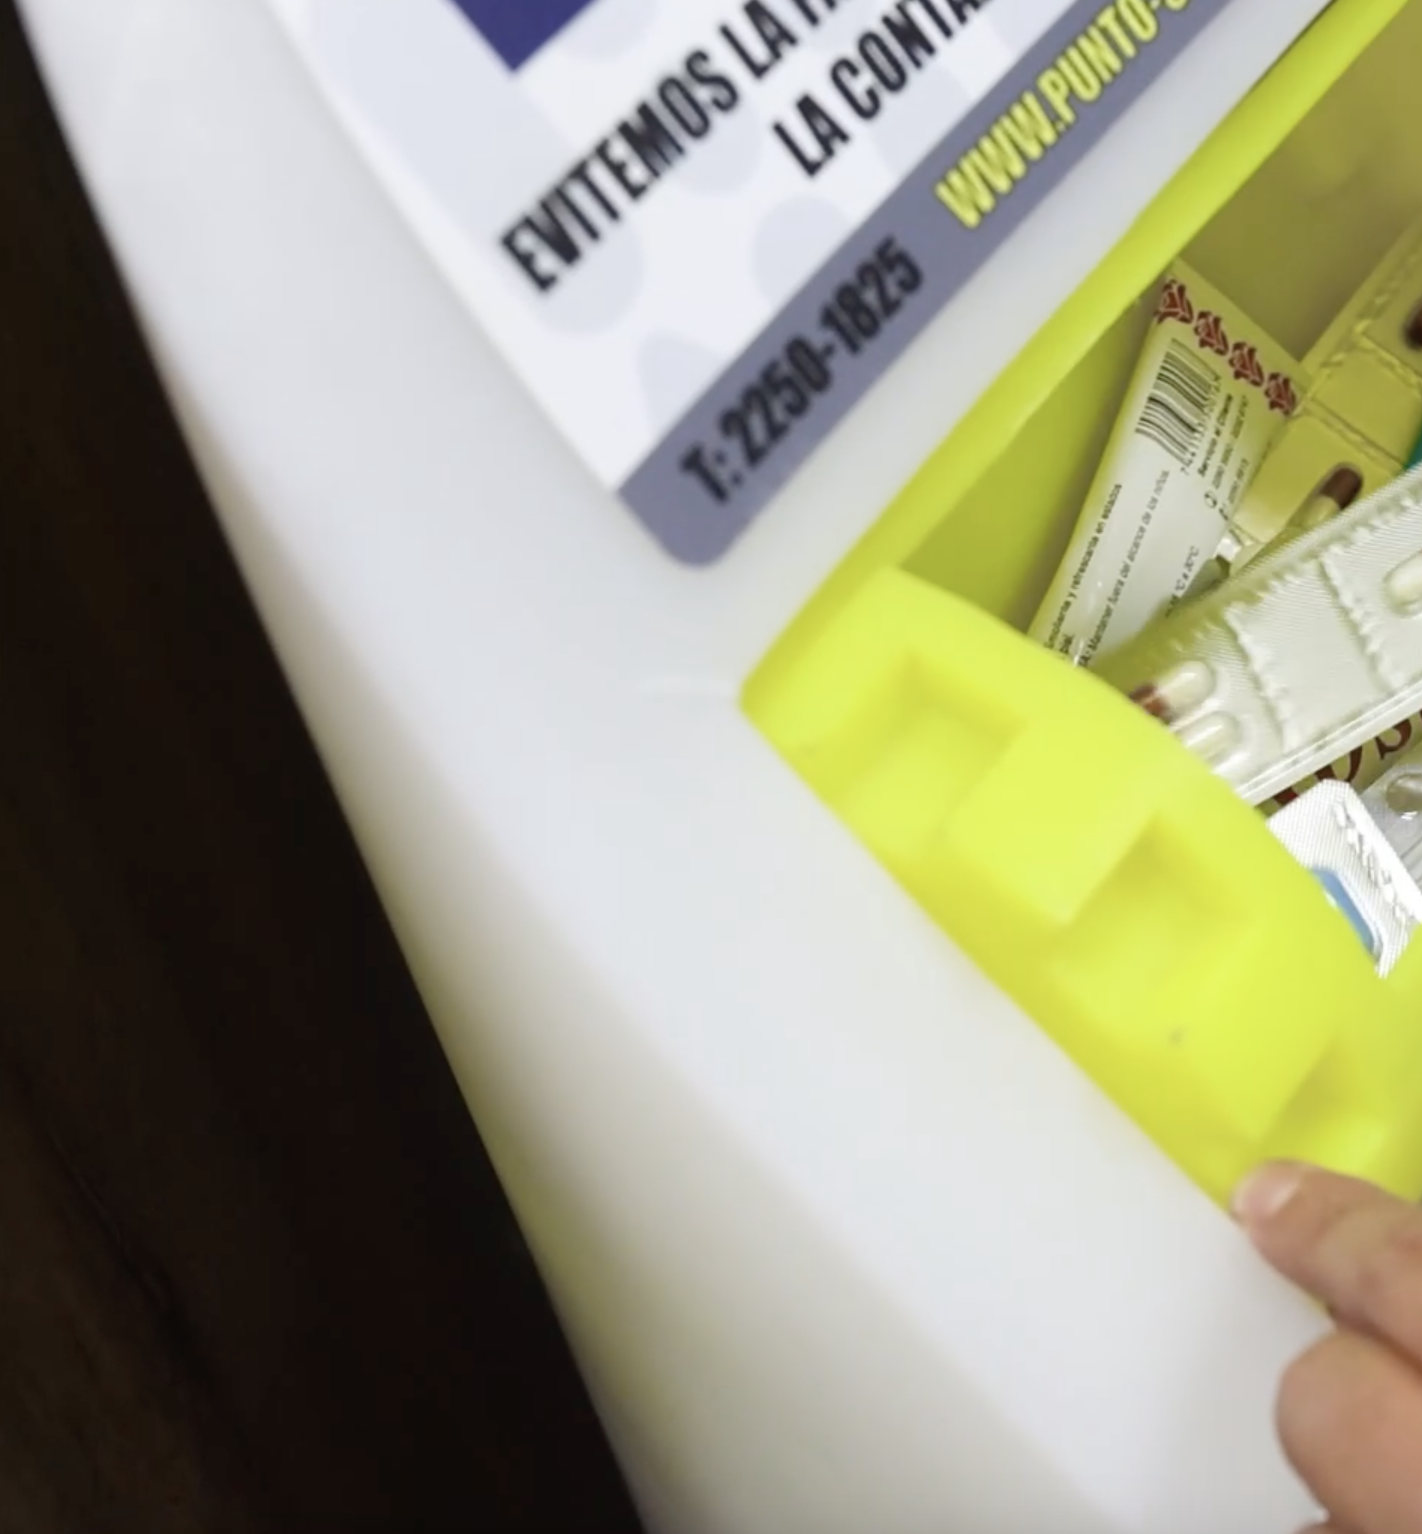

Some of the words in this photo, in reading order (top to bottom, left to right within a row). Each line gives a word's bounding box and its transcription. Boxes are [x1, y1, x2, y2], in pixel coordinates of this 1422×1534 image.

[500, 50, 739, 292] EVITEMOS
[719, 0, 797, 79] LA
[773, 94, 850, 178] LA
[680, 442, 745, 505] T:
[719, 234, 924, 468] 2250-1825
[1107, 578, 1125, 606] fuera
[1127, 525, 1146, 563] alcance
